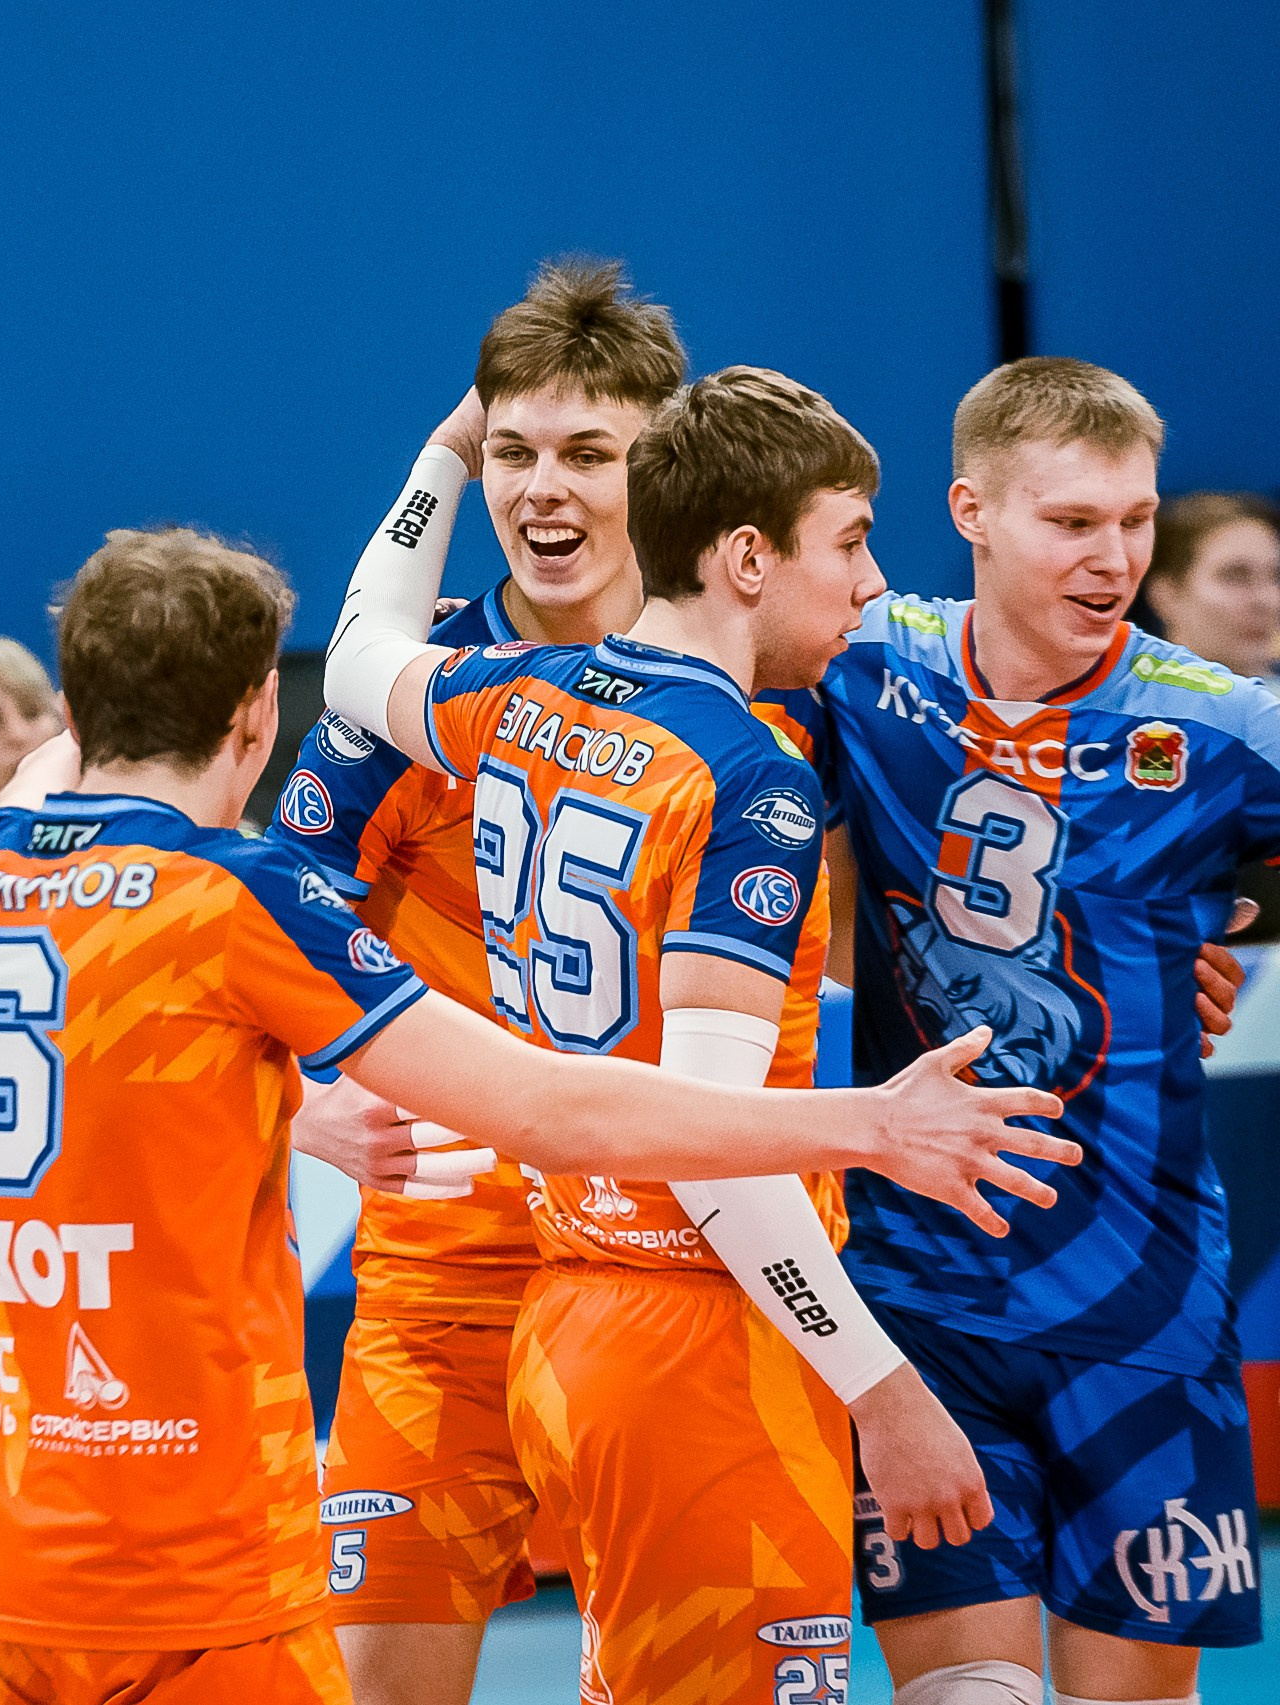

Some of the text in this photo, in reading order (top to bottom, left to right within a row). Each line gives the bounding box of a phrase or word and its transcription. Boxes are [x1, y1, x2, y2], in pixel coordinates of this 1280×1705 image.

[495, 692, 655, 787] ВЛАСКОВ
[745, 800, 816, 830] АВТОДОР
[925, 767, 1070, 959] 3
[474, 752, 652, 1055] 25
[30, 1413, 200, 1443] СТРОЙСЕРВИС
[328, 1527, 368, 1595] 5
[863, 1530, 905, 1592] 3
[773, 1653, 849, 1705] 25
